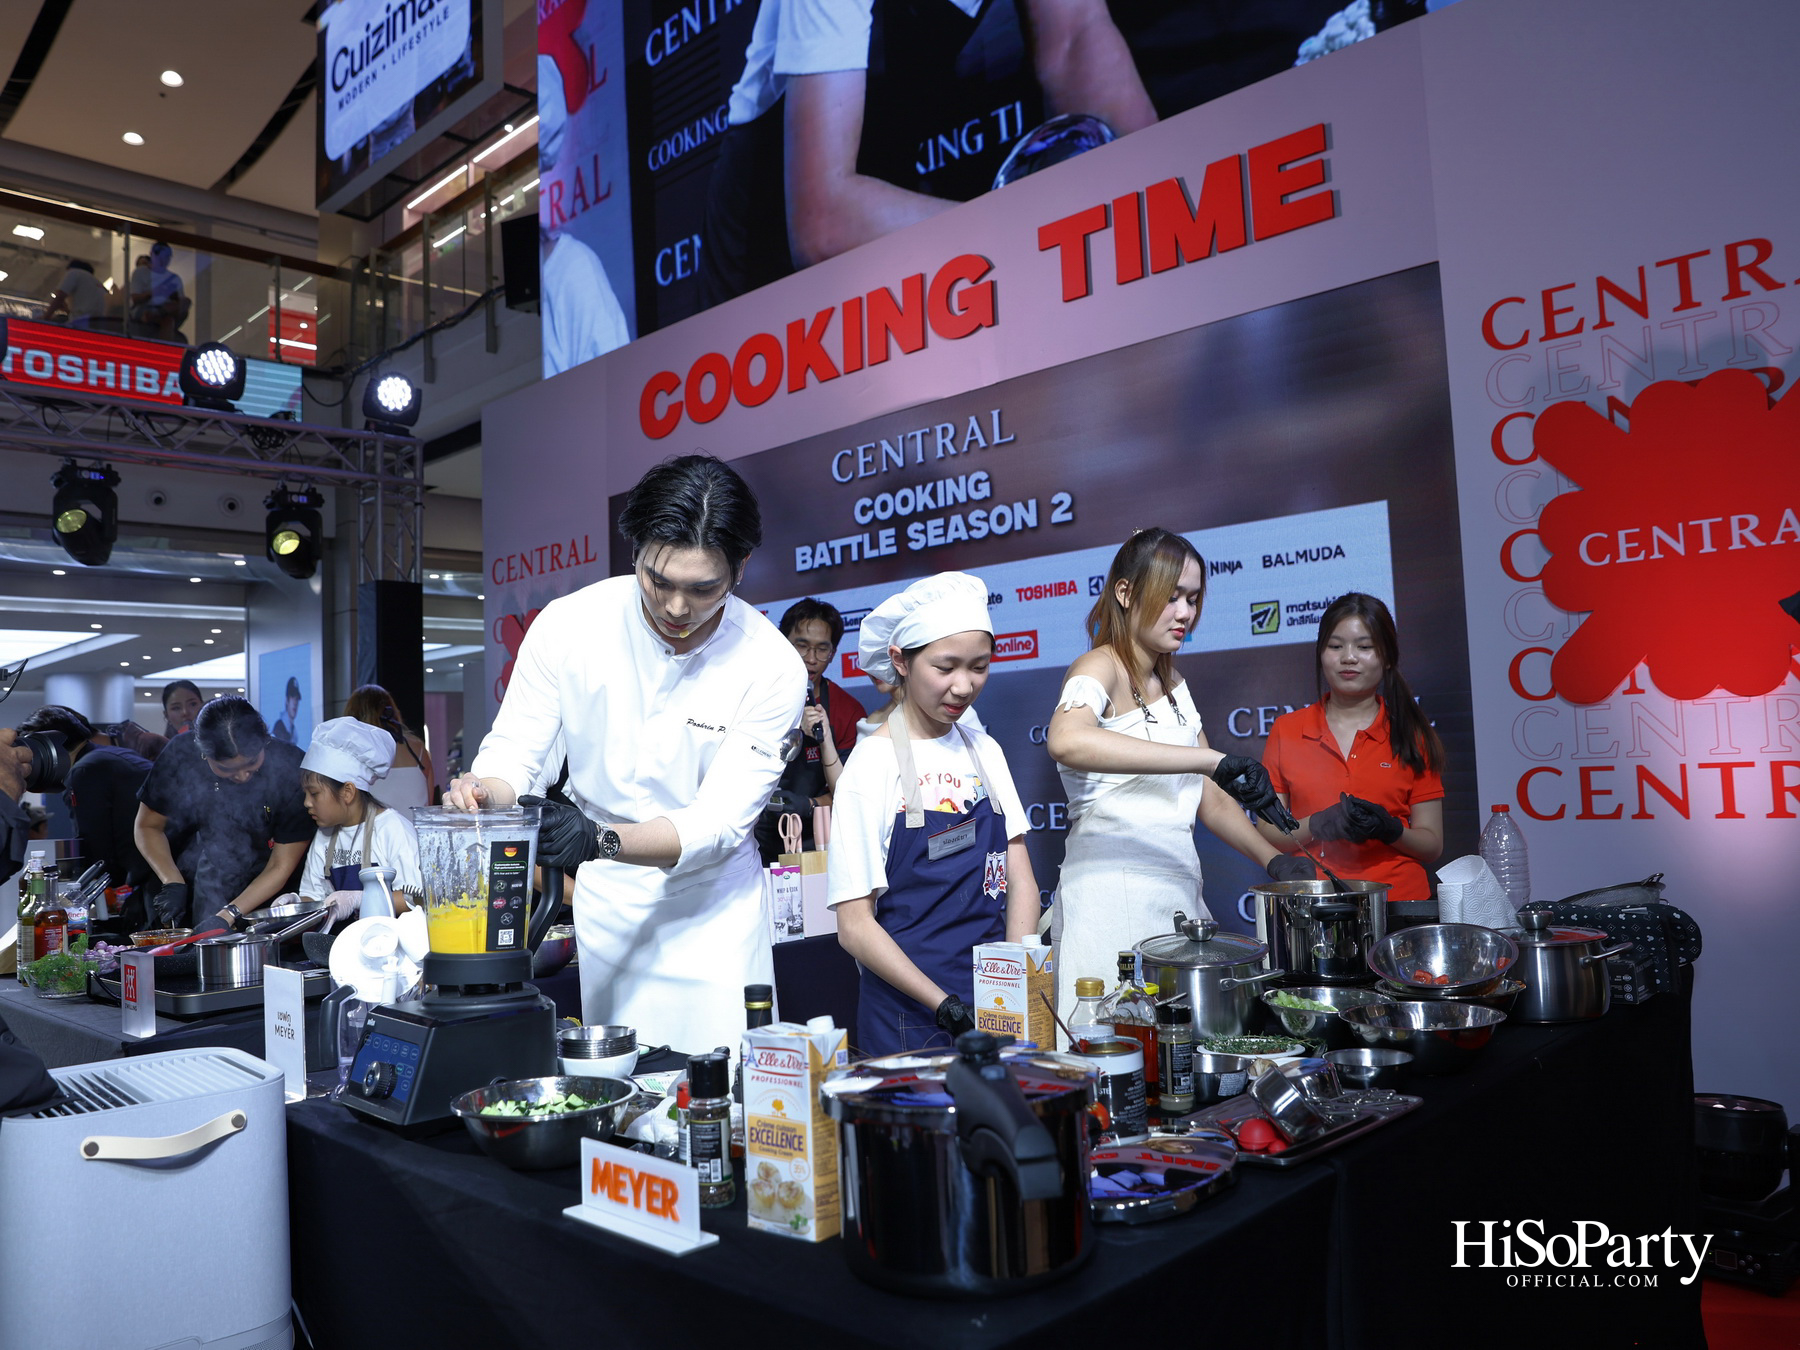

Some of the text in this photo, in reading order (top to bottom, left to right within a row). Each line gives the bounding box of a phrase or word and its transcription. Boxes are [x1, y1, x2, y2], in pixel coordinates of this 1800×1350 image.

[338, 5, 450, 111] MODERN LIFESTYLE
[638, 122, 1341, 440] COOKING TIME
[1481, 238, 1800, 351] CENTR
[1, 346, 184, 397] TOSHIBA
[831, 408, 1015, 483] CENTRAL
[854, 470, 991, 525] COOKING
[795, 491, 1073, 572] BATTLE SEASON 2
[492, 534, 598, 586] CENTRAL
[1262, 544, 1346, 569] BALMUDA
[1016, 580, 1078, 602] TOSHIBA
[936, 772, 961, 789] YOU
[984, 961, 1000, 974] Elle
[979, 978, 1021, 989] PROFESSIONNEL
[274, 1023, 295, 1041] MEYER
[979, 1016, 1022, 1034] EXCELLENCE
[758, 1051, 780, 1067] Elle
[751, 1074, 804, 1089] PROFESSIONNEL
[750, 1126, 804, 1152] EXCELLENCE
[591, 1156, 680, 1223] MEYER
